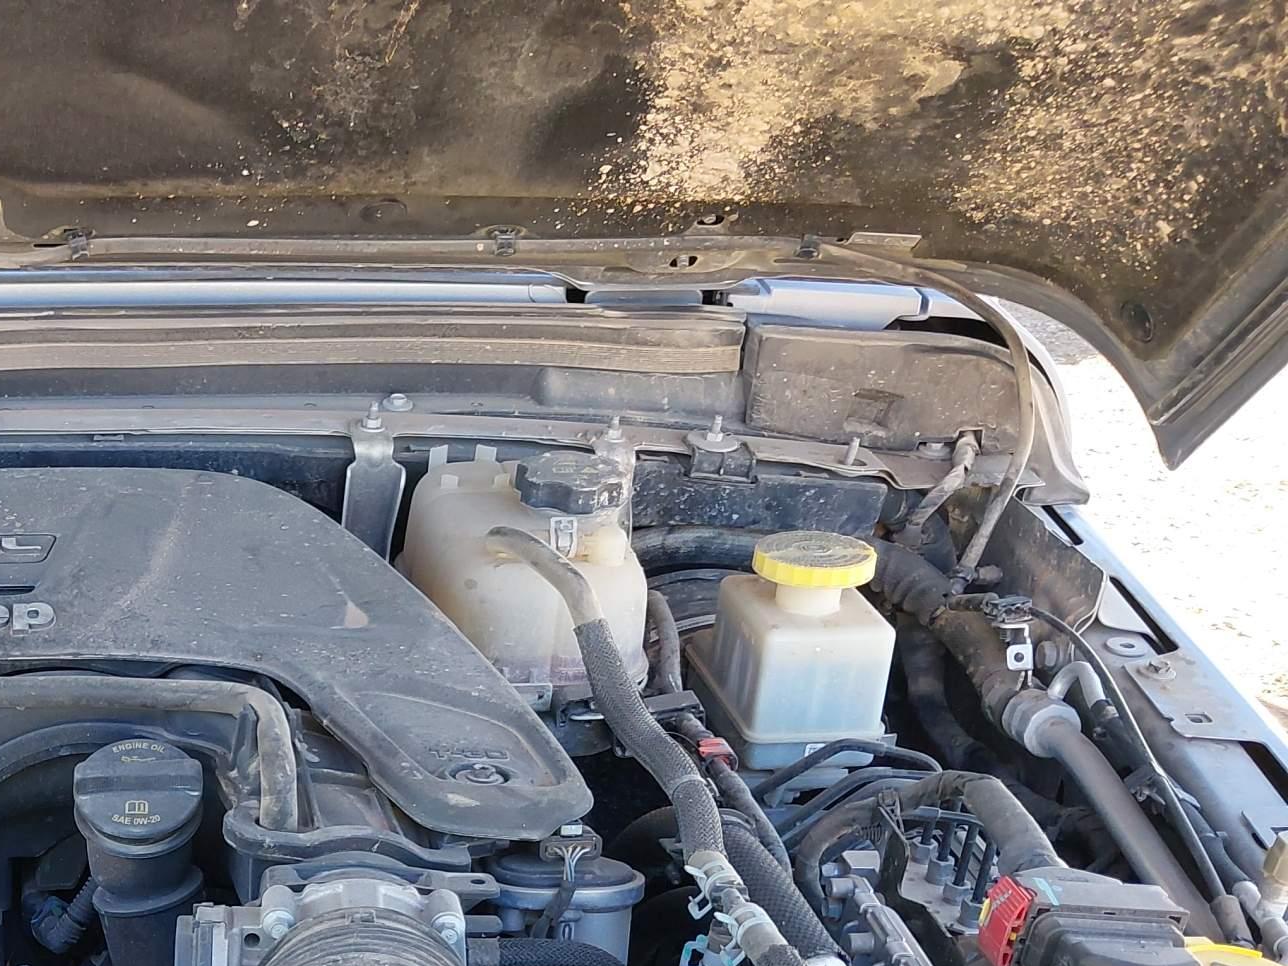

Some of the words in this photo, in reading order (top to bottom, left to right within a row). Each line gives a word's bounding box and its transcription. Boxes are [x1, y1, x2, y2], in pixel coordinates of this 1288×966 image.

[111, 742, 149, 753] ENGINE
[150, 743, 166, 753] OIL
[111, 813, 132, 825] SAE
[133, 814, 161, 825] 0W-20
